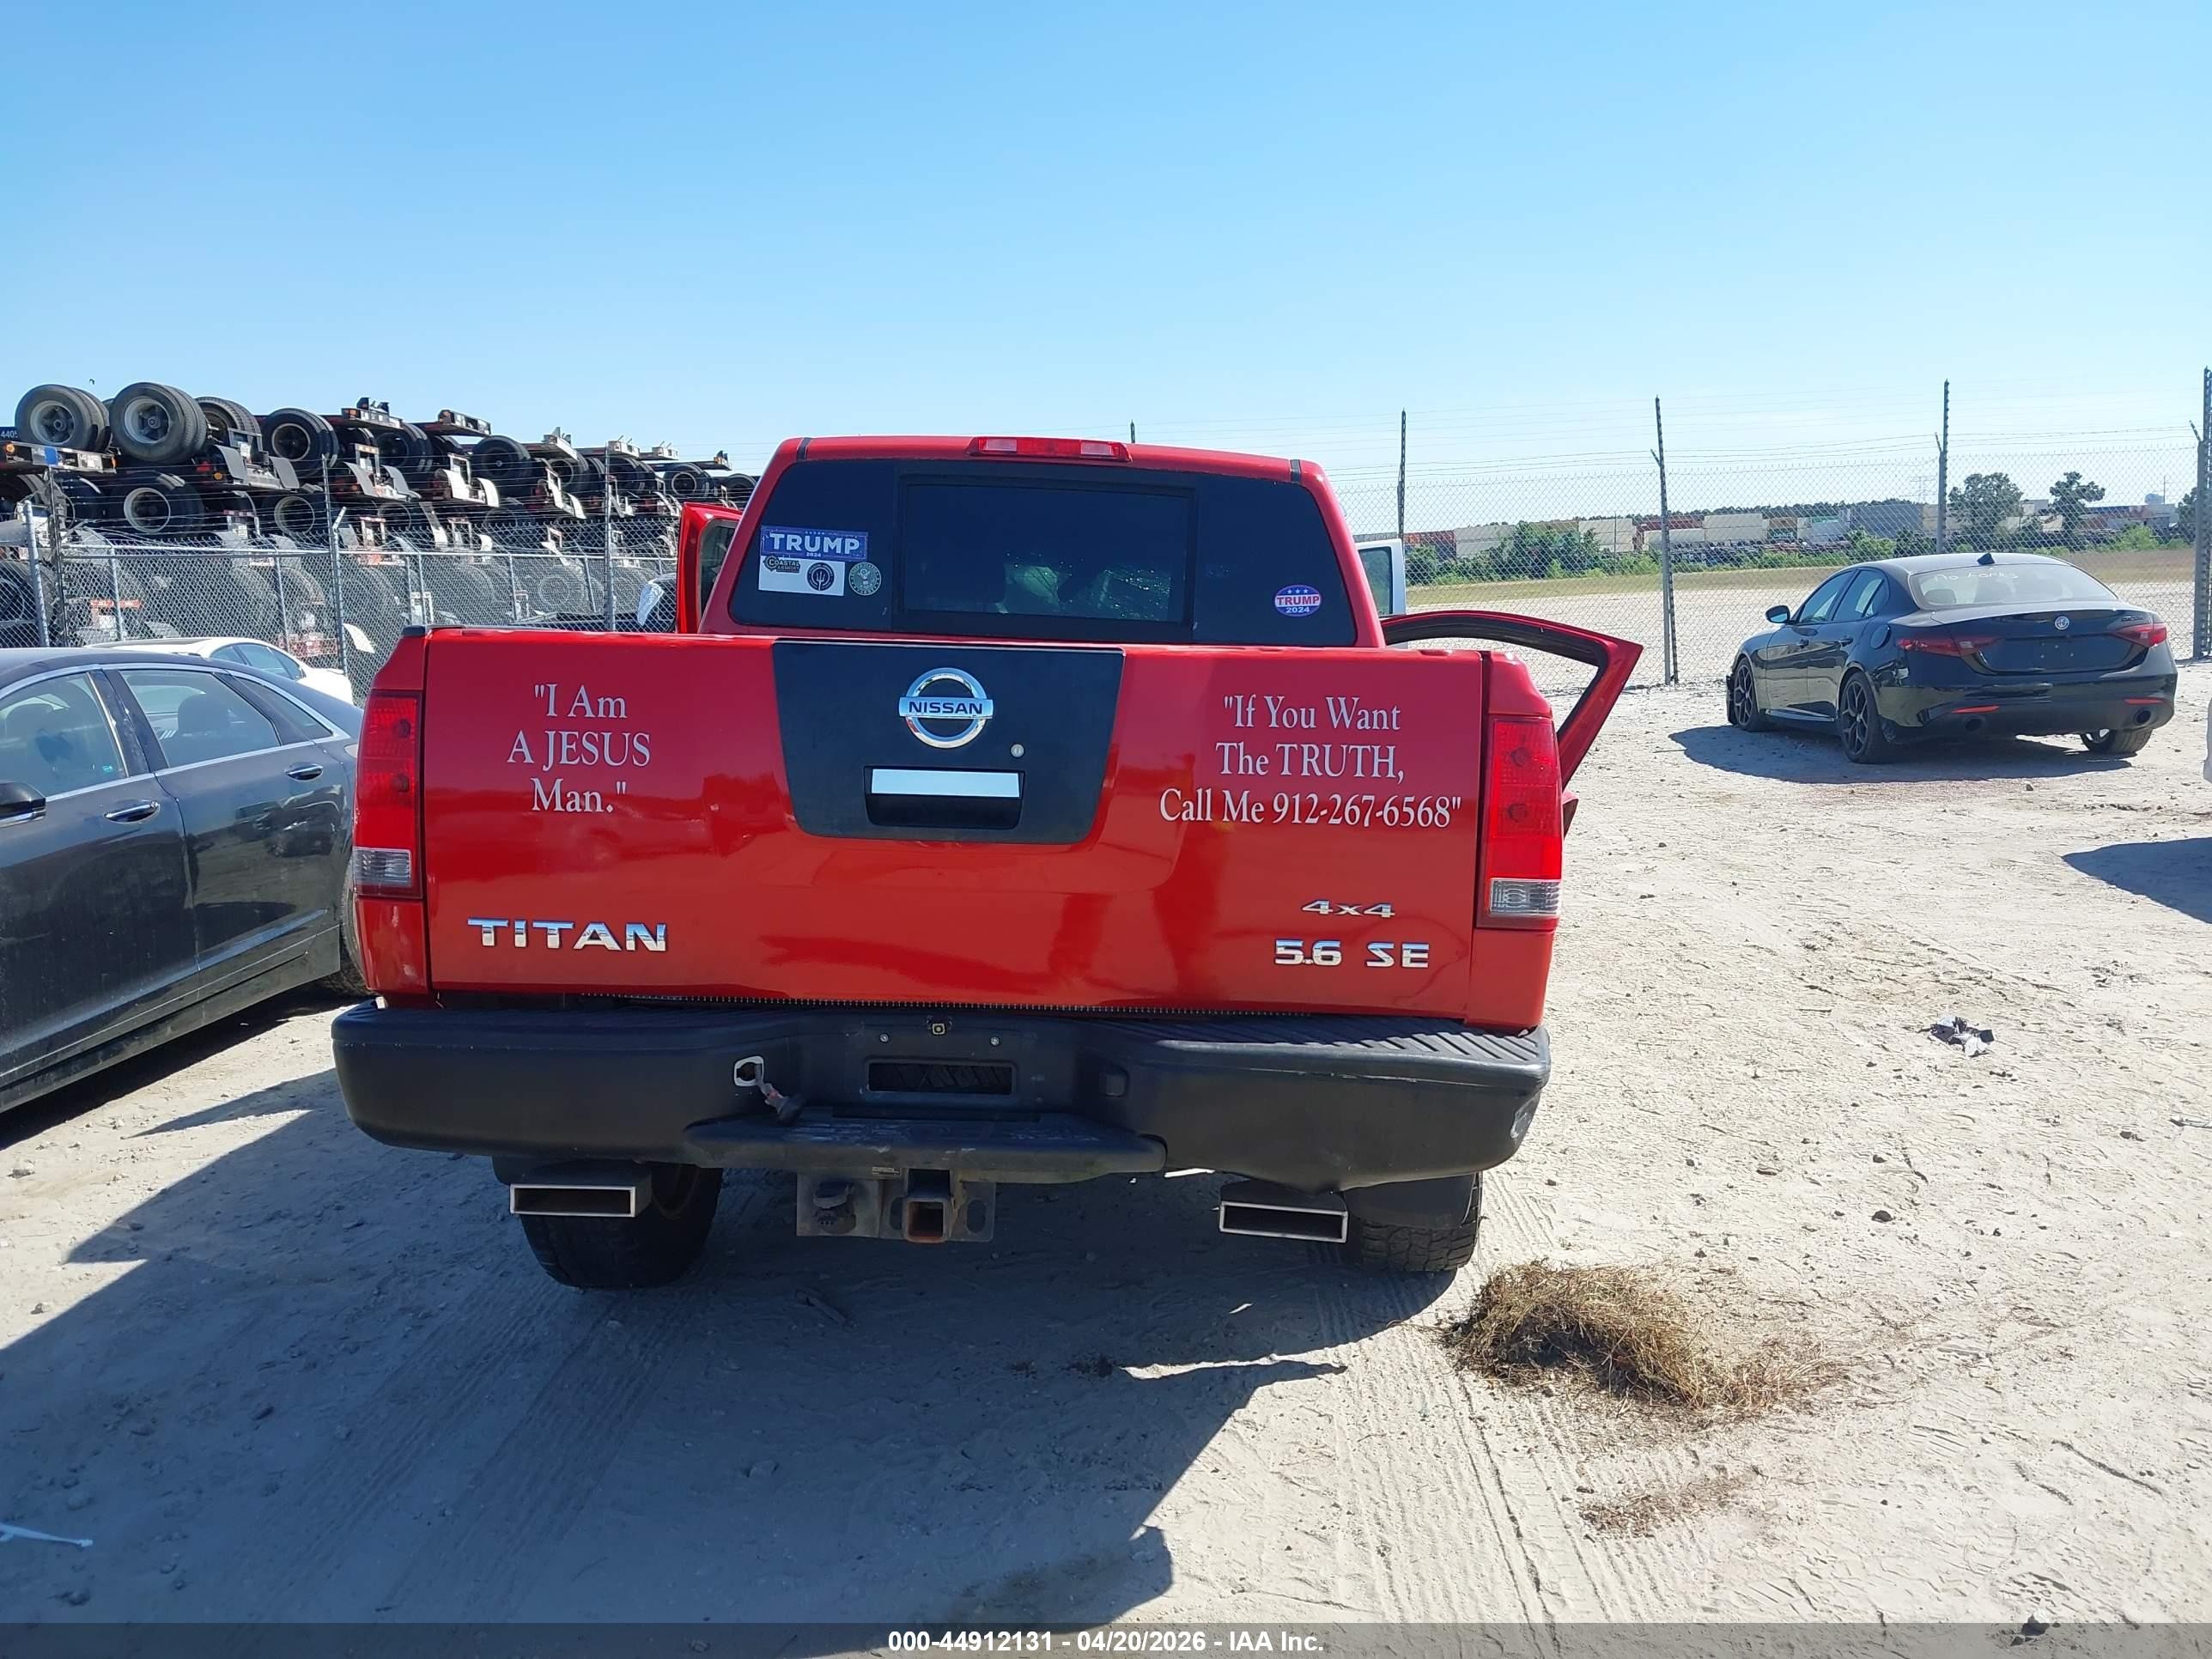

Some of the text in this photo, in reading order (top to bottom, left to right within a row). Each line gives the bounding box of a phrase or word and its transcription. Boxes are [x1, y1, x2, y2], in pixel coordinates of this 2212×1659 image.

[769, 532, 860, 555] TRUMP
[769, 558, 799, 567] COASTAL
[1276, 596, 1320, 605] TRUMP
[534, 684, 628, 719] "I Am
[908, 701, 983, 714] NISSAN
[1223, 694, 1401, 731] "If You Want
[507, 730, 651, 772] A JESUS
[1215, 742, 1405, 784] The TRUTH,
[531, 777, 627, 813] Man."
[1159, 787, 1462, 828] Call Me 912-267-6568"
[1301, 899, 1396, 919] 4x4
[466, 917, 667, 952] TITAN
[1274, 939, 1431, 969] 5.6 SE
